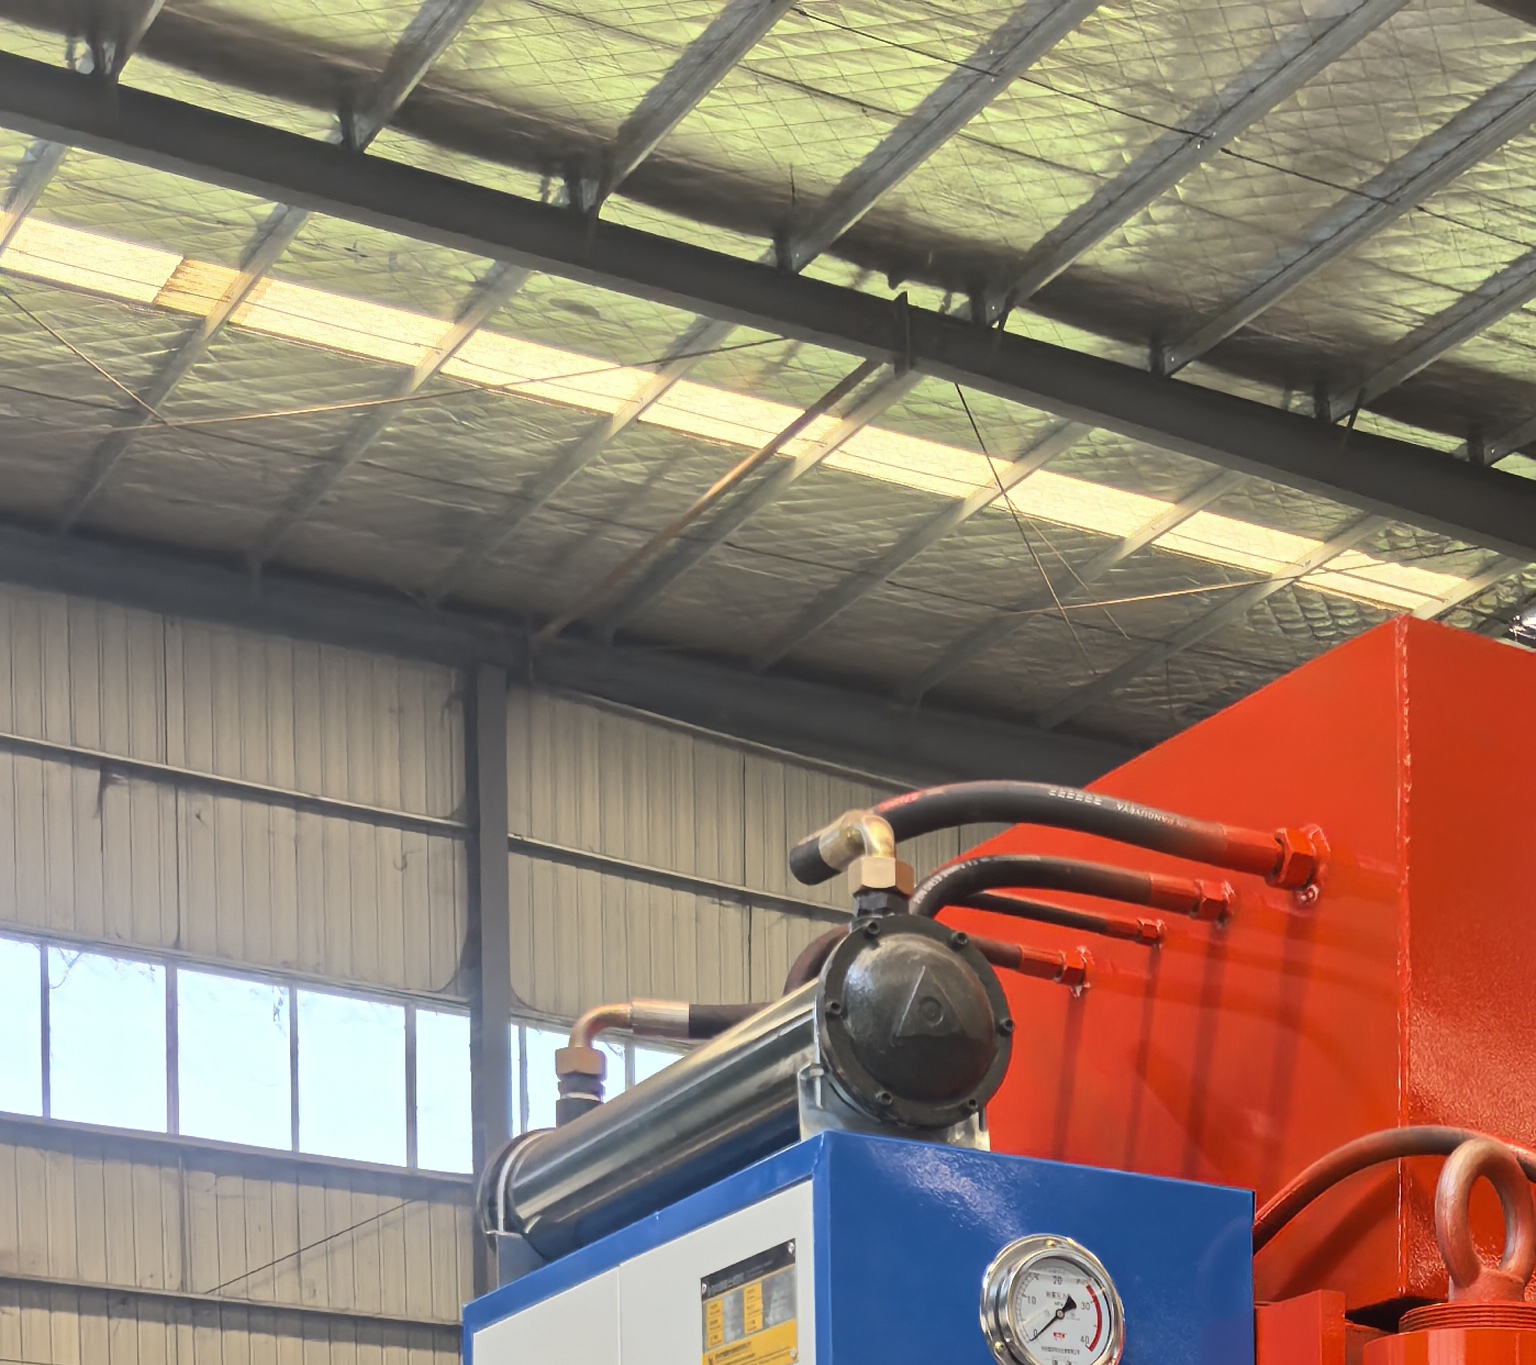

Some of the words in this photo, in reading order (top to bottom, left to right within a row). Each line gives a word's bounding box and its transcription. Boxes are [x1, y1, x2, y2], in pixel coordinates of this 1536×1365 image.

[1053, 1276, 1062, 1285] 20
[1027, 1296, 1036, 1304] 10
[1081, 1302, 1090, 1311] 30
[1080, 1335, 1090, 1344] 40
